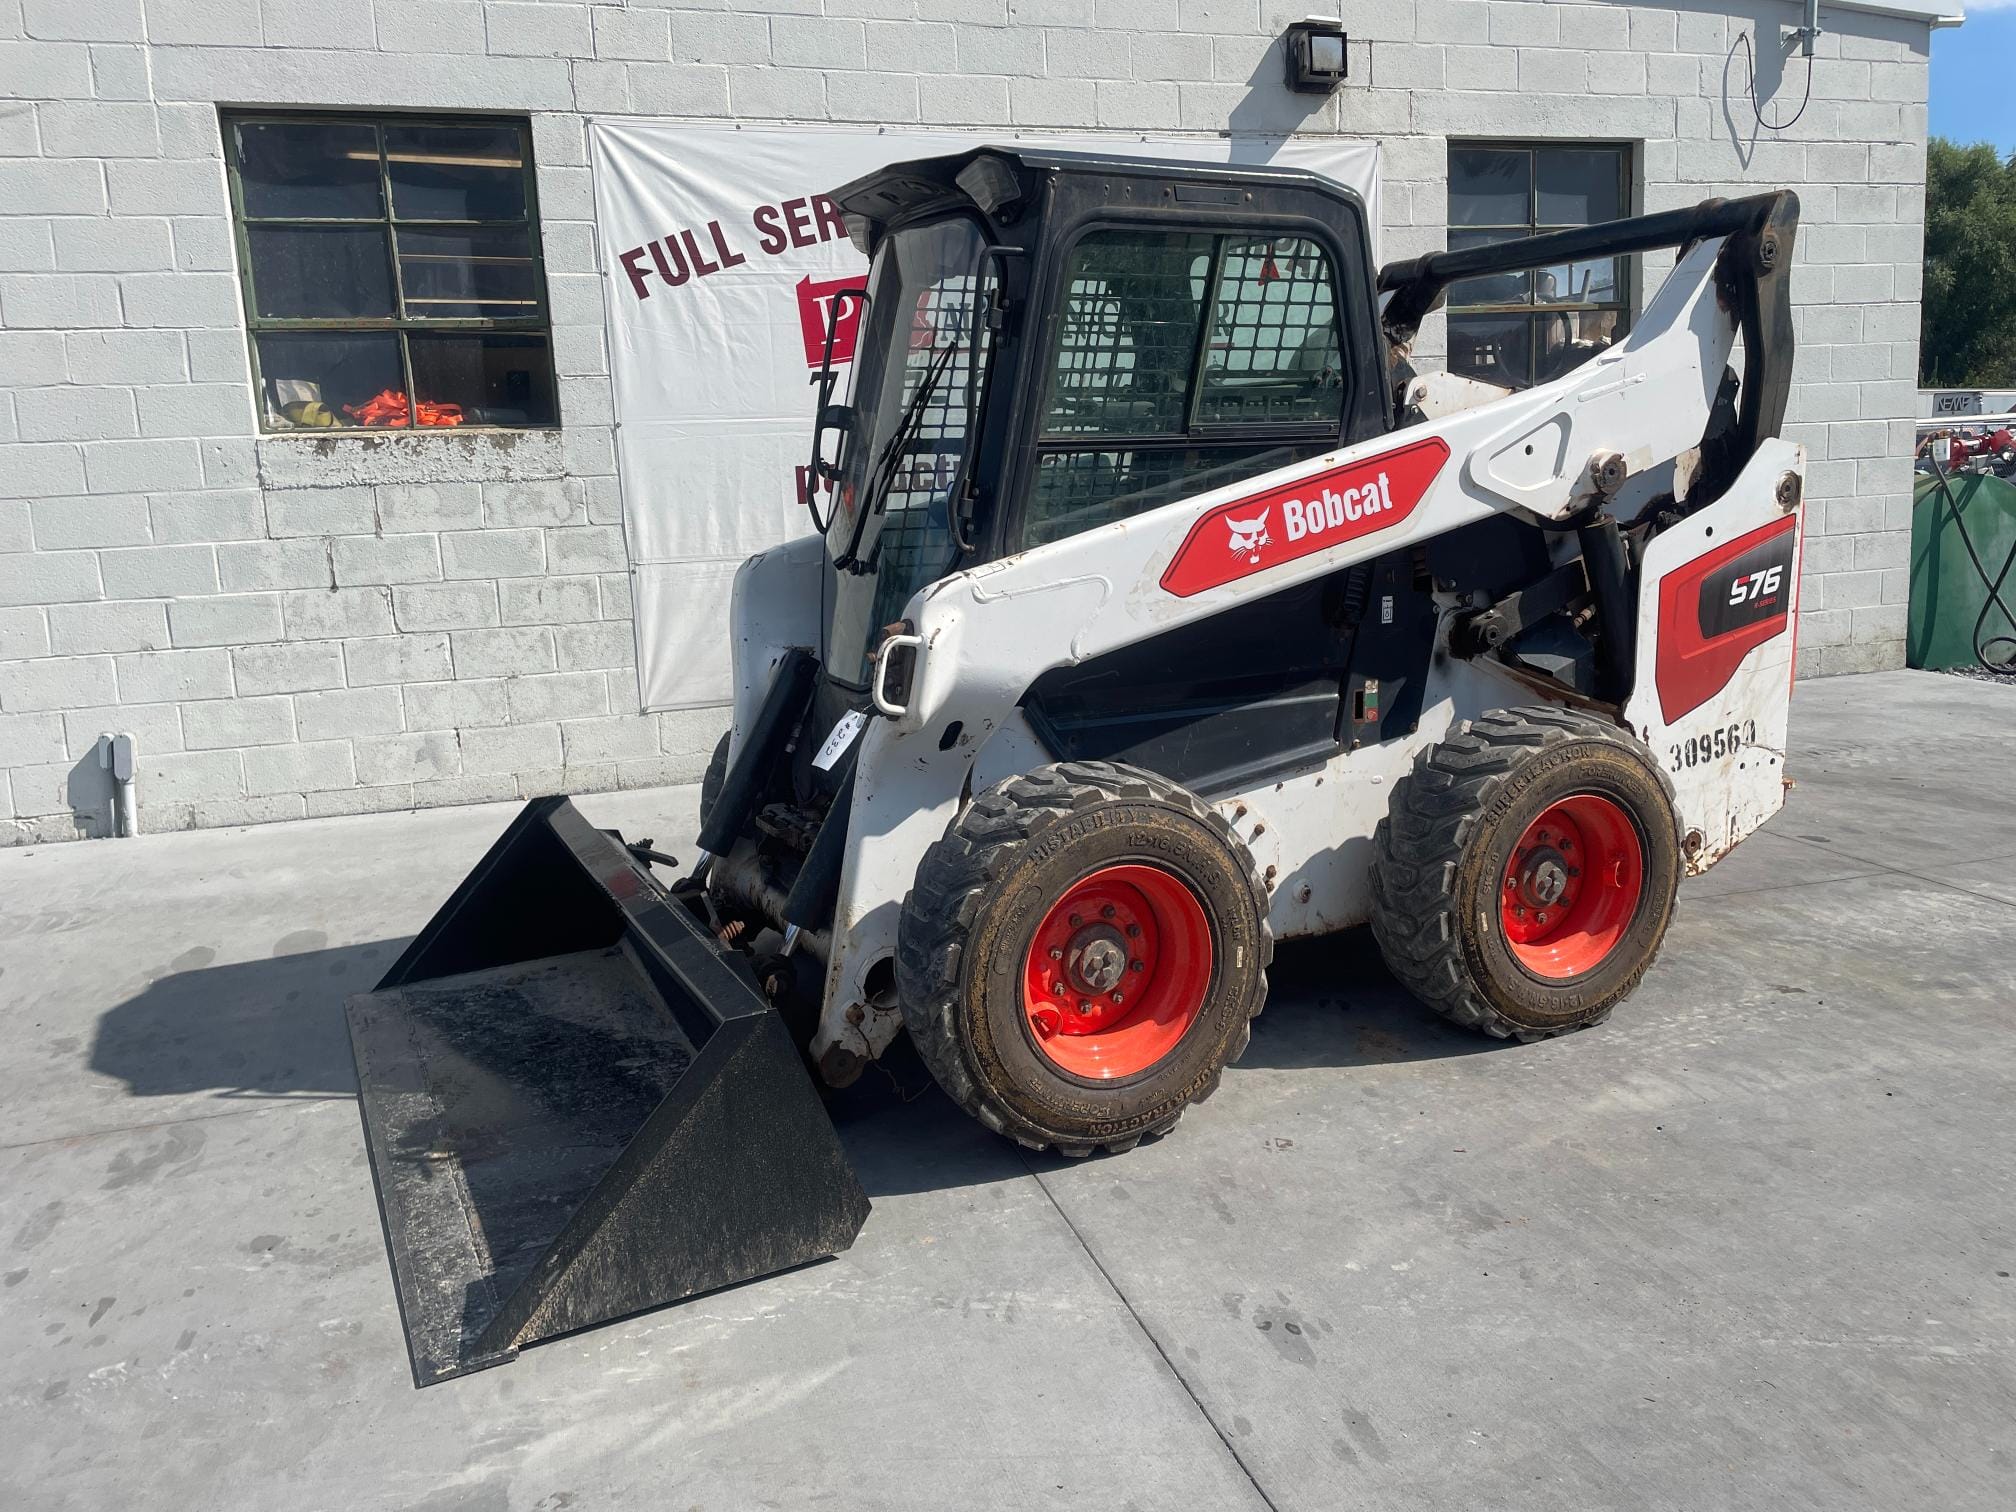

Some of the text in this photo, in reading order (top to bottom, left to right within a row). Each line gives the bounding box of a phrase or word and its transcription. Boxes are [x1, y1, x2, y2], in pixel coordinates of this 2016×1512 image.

[619, 193, 850, 300] FULL SER
[1282, 471, 1393, 542] Bobcat
[1729, 565, 1783, 606] S76
